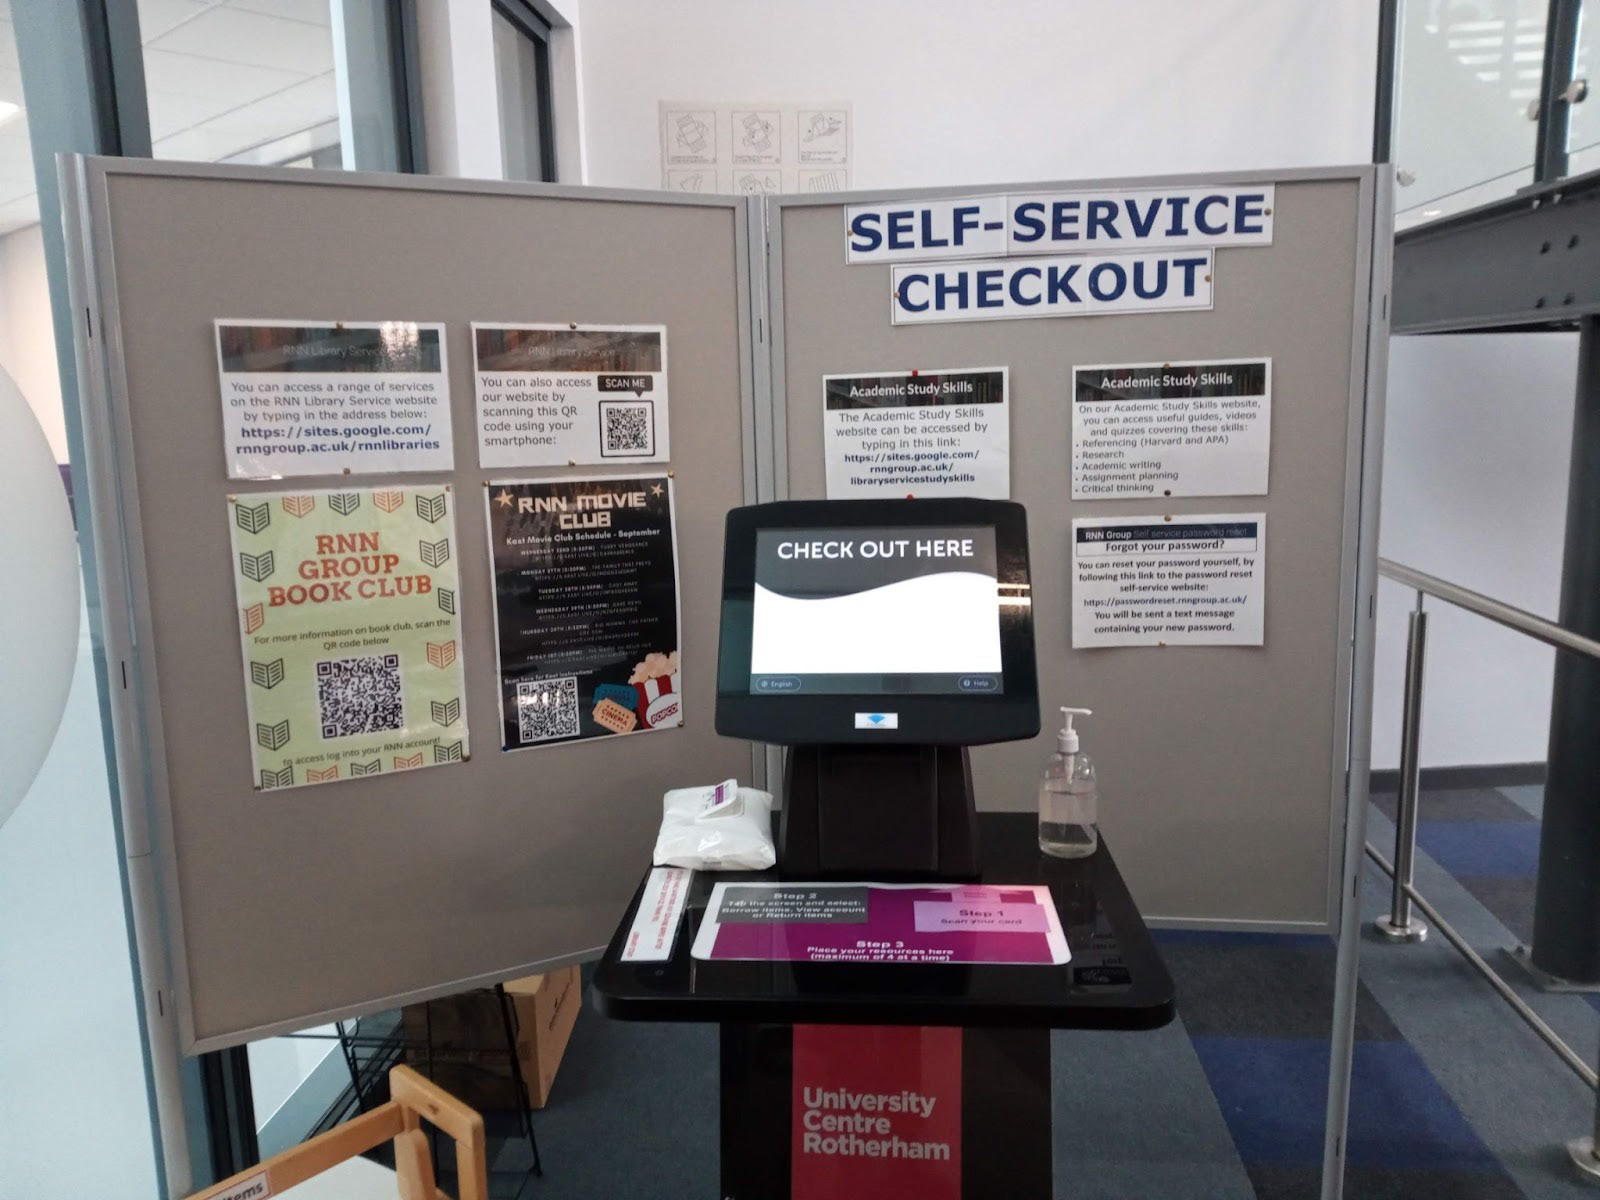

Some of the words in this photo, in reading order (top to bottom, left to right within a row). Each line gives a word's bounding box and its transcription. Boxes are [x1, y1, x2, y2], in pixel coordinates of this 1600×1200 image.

[850, 194, 1265, 252] SELF-SERVICE
[898, 258, 1207, 312] CHECKOUT
[482, 377, 502, 387] You
[507, 378, 526, 387] can
[530, 377, 552, 387] also
[556, 378, 591, 387] access
[606, 379, 629, 388] SCAN
[632, 379, 645, 387] ME
[1101, 375, 1160, 389] Academic
[1163, 374, 1198, 389] Study
[1201, 372, 1233, 385] Skills
[231, 382, 253, 392] You
[258, 384, 278, 392] can
[284, 383, 322, 392] access
[338, 383, 369, 393] range
[375, 382, 385, 391] of
[389, 382, 434, 391] services
[850, 384, 905, 397] Academic
[907, 383, 940, 397] Study
[943, 381, 973, 393] Skills
[230, 398, 245, 406] on
[250, 397, 270, 406] the
[275, 397, 300, 406] RNN
[305, 395, 344, 407] Library
[350, 396, 391, 405] Service
[395, 395, 437, 405] website
[483, 394, 502, 402] our
[506, 392, 548, 401] website
[552, 392, 565, 403] by
[483, 407, 533, 418] scanning
[538, 406, 557, 416] this
[562, 406, 577, 416] QR
[1079, 405, 1092, 413] On
[1114, 403, 1159, 412] Academic
[1163, 403, 1189, 412] Study
[1193, 401, 1218, 409] Skills
[1221, 400, 1260, 409] website,
[244, 411, 257, 422] by
[263, 411, 300, 422] typing
[305, 411, 314, 419] in
[319, 410, 338, 419] the
[342, 410, 386, 419] address
[391, 409, 426, 418] below:
[840, 413, 859, 422] The
[863, 411, 915, 422] Academic
[919, 411, 950, 421] Study
[955, 408, 984, 418] Skills
[1084, 417, 1099, 426] you
[1103, 416, 1119, 424] can
[1123, 415, 1153, 423] access
[1157, 413, 1185, 422] useful
[1188, 412, 1222, 422] guides,
[1226, 412, 1256, 420] videos
[241, 425, 431, 440] https://sites.google.com/
[484, 422, 510, 431] code
[515, 422, 544, 432] using
[549, 422, 573, 432] your
[836, 427, 877, 437] website
[881, 427, 900, 435] can
[904, 425, 917, 434] be
[921, 423, 970, 433] accessed
[975, 423, 987, 433] by
[1091, 427, 1107, 436] and
[1111, 427, 1145, 436] quizzes
[1149, 425, 1188, 435] covering
[1192, 424, 1217, 432] these
[1221, 423, 1248, 431] skills:
[236, 440, 440, 455] rnngroup.ac.uk/rnnlibraries
[485, 436, 556, 447] smartphone:
[862, 441, 895, 451] typing
[900, 439, 909, 448] in
[913, 439, 933, 448] this
[938, 438, 961, 447] link:
[1083, 438, 1137, 448] Referencing
[1141, 436, 1181, 447] (Harvard
[1185, 436, 1202, 444] and
[1206, 435, 1228, 445] APA)
[845, 450, 979, 463] https://sites.google.com/
[1082, 450, 1124, 459] Research
[870, 463, 953, 474] rnngroup.ac.uk/
[1082, 462, 1126, 471] Academic
[1130, 461, 1161, 470] writing
[851, 474, 975, 487] libraryservicestudyskills
[1082, 473, 1135, 482] Assignment
[1139, 471, 1178, 481] planning
[1082, 484, 1113, 493] Critical
[1117, 483, 1154, 492] thinking
[518, 496, 567, 513] RNN
[577, 492, 647, 510] MOVIE
[559, 511, 611, 530] CLUB
[507, 537, 525, 545] Kast
[528, 535, 552, 544] Movie
[554, 533, 573, 541] Club
[576, 531, 611, 540] Schedule
[618, 529, 660, 539] September
[1085, 531, 1104, 540] RNN
[1107, 531, 1132, 540] Group
[316, 532, 379, 555] RNN
[777, 542, 853, 559] CHECK
[859, 541, 909, 558] OUT
[916, 540, 973, 557] HERE
[1106, 543, 1138, 553] Forgot
[1142, 543, 1165, 552] your
[1169, 540, 1225, 550] password?
[298, 554, 399, 580] GROUP
[1136, 561, 1155, 569] your
[1158, 559, 1200, 568] password
[1203, 557, 1240, 568] yourself,
[1244, 558, 1254, 567] by
[1079, 573, 1118, 582] following
[1121, 572, 1136, 580] this
[1185, 570, 1227, 580] password
[1230, 570, 1252, 578] reset
[268, 581, 352, 607] BOOK
[358, 575, 432, 598] CLUB
[1120, 584, 1168, 592] self-service
[1171, 583, 1208, 591] website:
[1095, 611, 1110, 619] You
[1113, 610, 1128, 618] will
[1132, 610, 1142, 618] be
[1145, 610, 1164, 618] sent
[1095, 625, 1140, 633] containing
[1143, 625, 1163, 634] your
[1188, 623, 1234, 632] password.
[323, 641, 337, 650] QR
[340, 640, 360, 648] code
[363, 637, 389, 646] below
[771, 680, 792, 688] English
[602, 708, 627, 727] CINEMA
[804, 1087, 936, 1118] University
[803, 1110, 891, 1134] Centre
[804, 1133, 950, 1160] Rotherham
